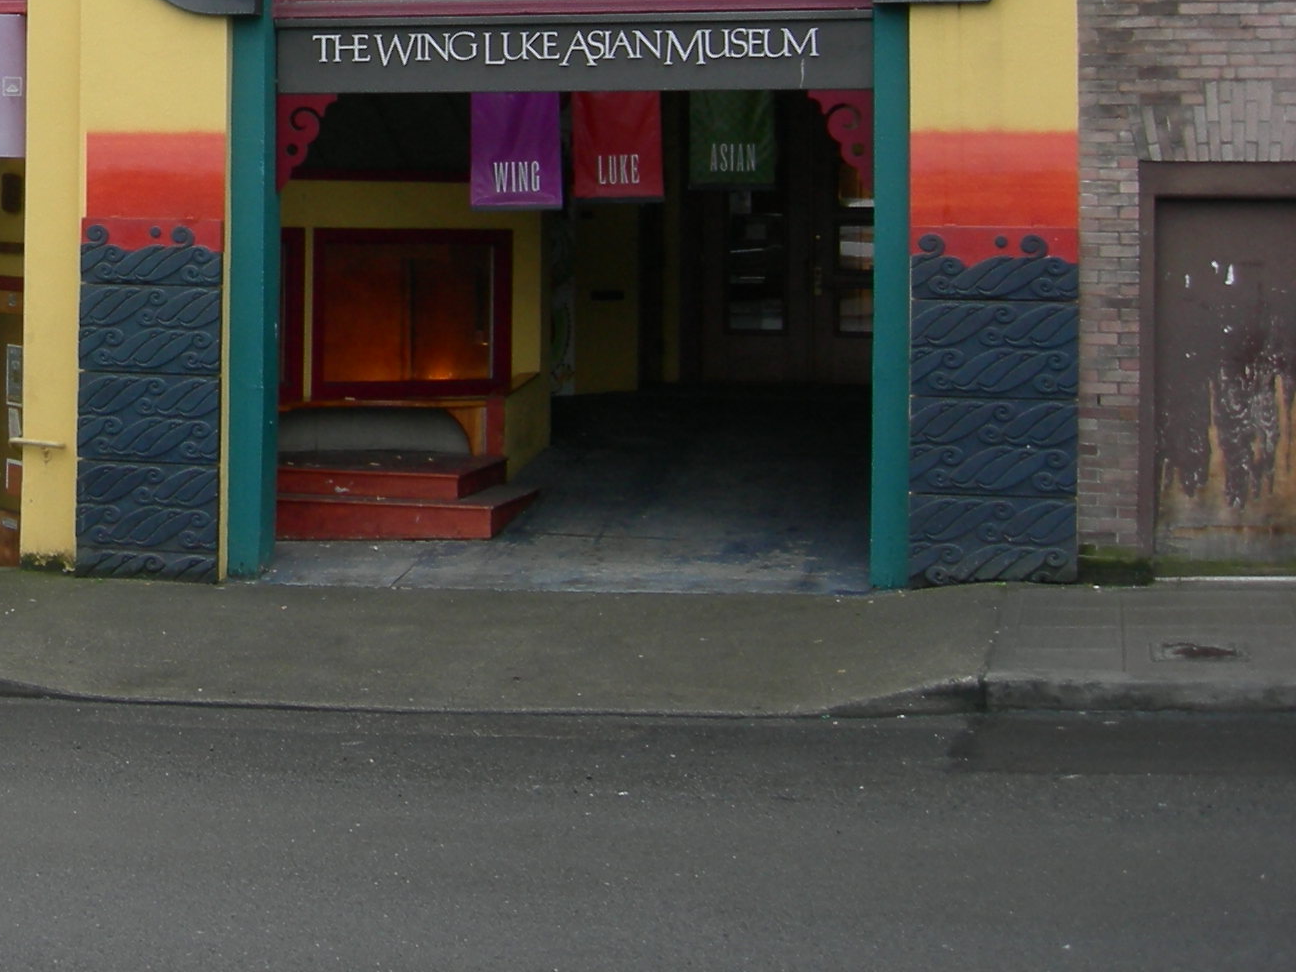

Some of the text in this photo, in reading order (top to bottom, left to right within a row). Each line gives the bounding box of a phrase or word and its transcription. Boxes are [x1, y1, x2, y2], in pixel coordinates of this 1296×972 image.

[312, 27, 820, 67] THE WING LUKE ASIAN MUSEUM
[597, 154, 641, 185] LUKE
[710, 143, 757, 173] ASIAN
[493, 160, 541, 193] WING
